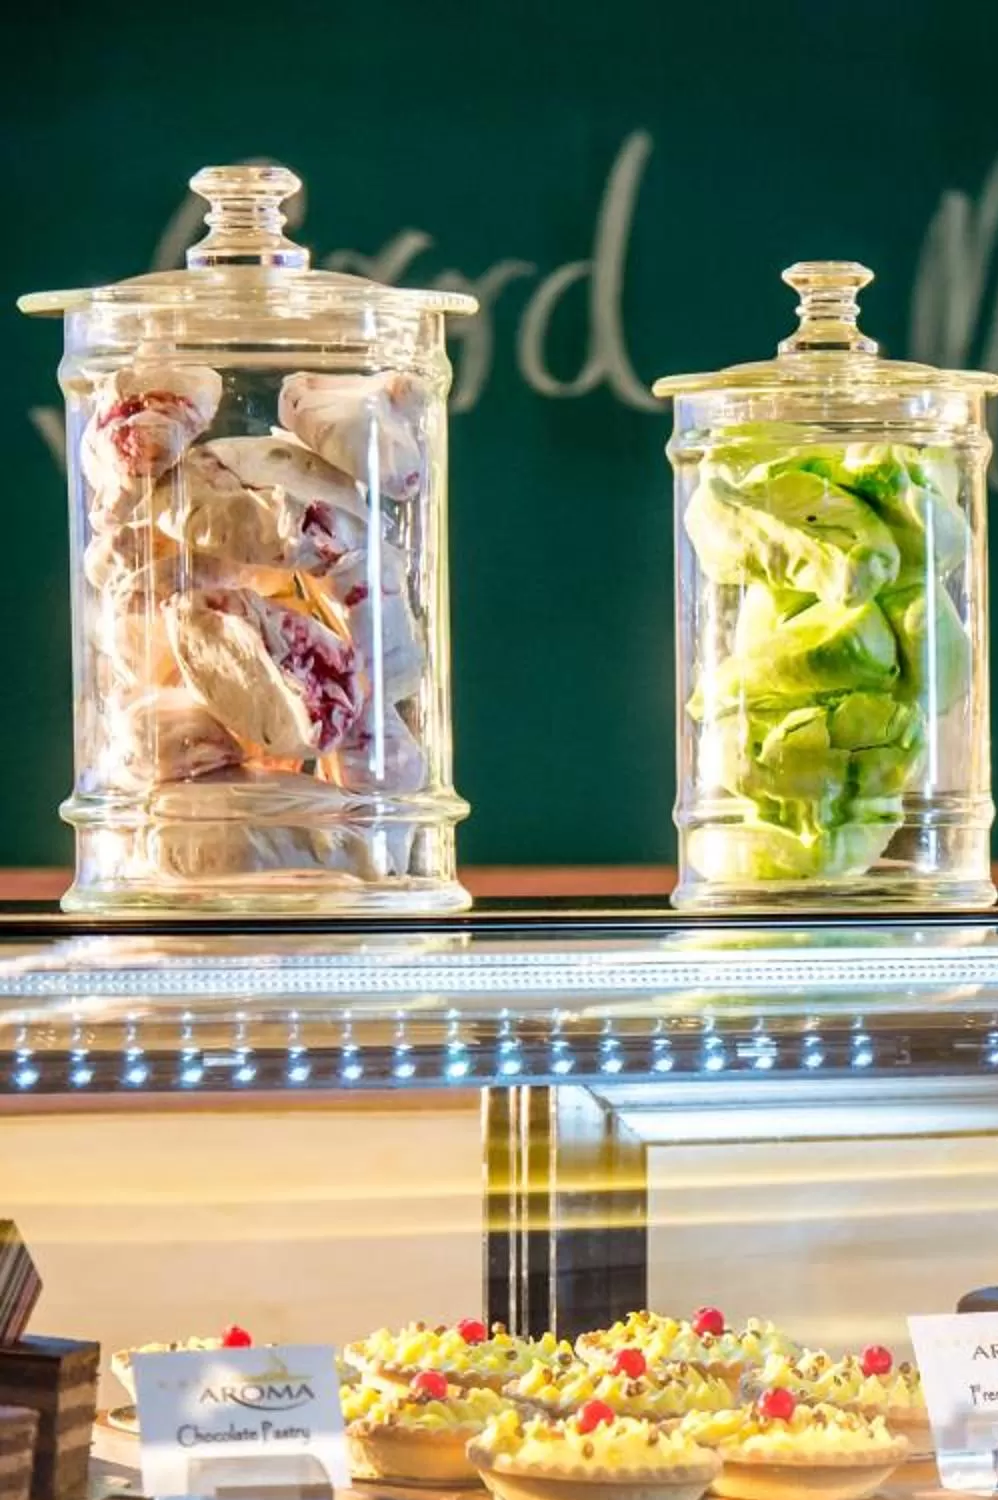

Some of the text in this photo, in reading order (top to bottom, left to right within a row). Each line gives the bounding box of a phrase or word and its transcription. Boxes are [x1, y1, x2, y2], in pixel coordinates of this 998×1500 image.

[200, 1384, 315, 1410] AROMA
[176, 1421, 310, 1448] Chocolate Pastry
